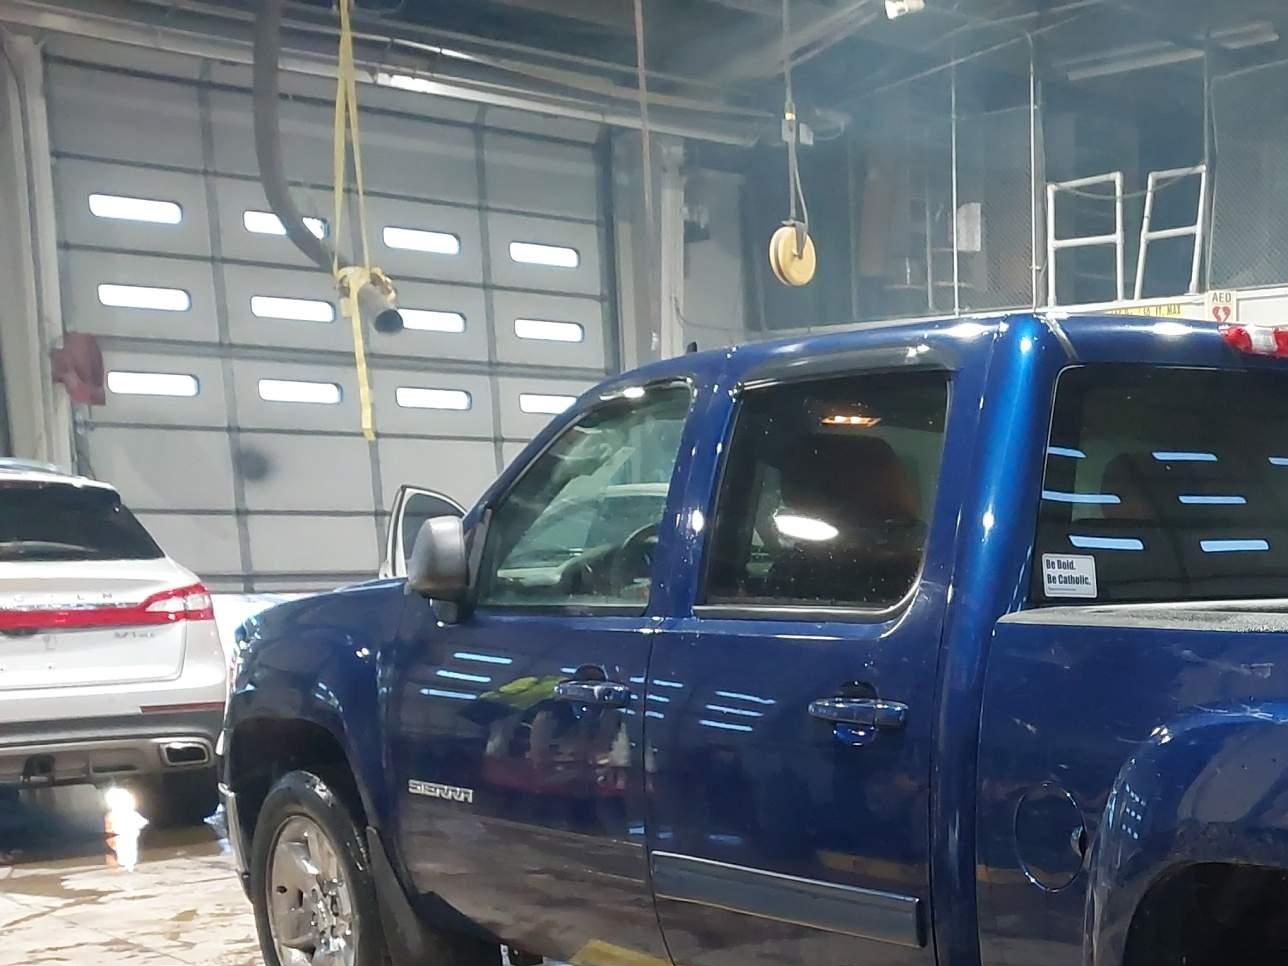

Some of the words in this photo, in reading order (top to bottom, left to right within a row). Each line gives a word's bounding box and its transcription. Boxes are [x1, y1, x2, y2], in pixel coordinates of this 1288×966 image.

[1211, 292, 1232, 303] AED
[1046, 559, 1056, 570] Be
[1047, 574, 1057, 585] Be
[1058, 574, 1091, 586] Catholic.
[408, 779, 474, 803] SIERRA
